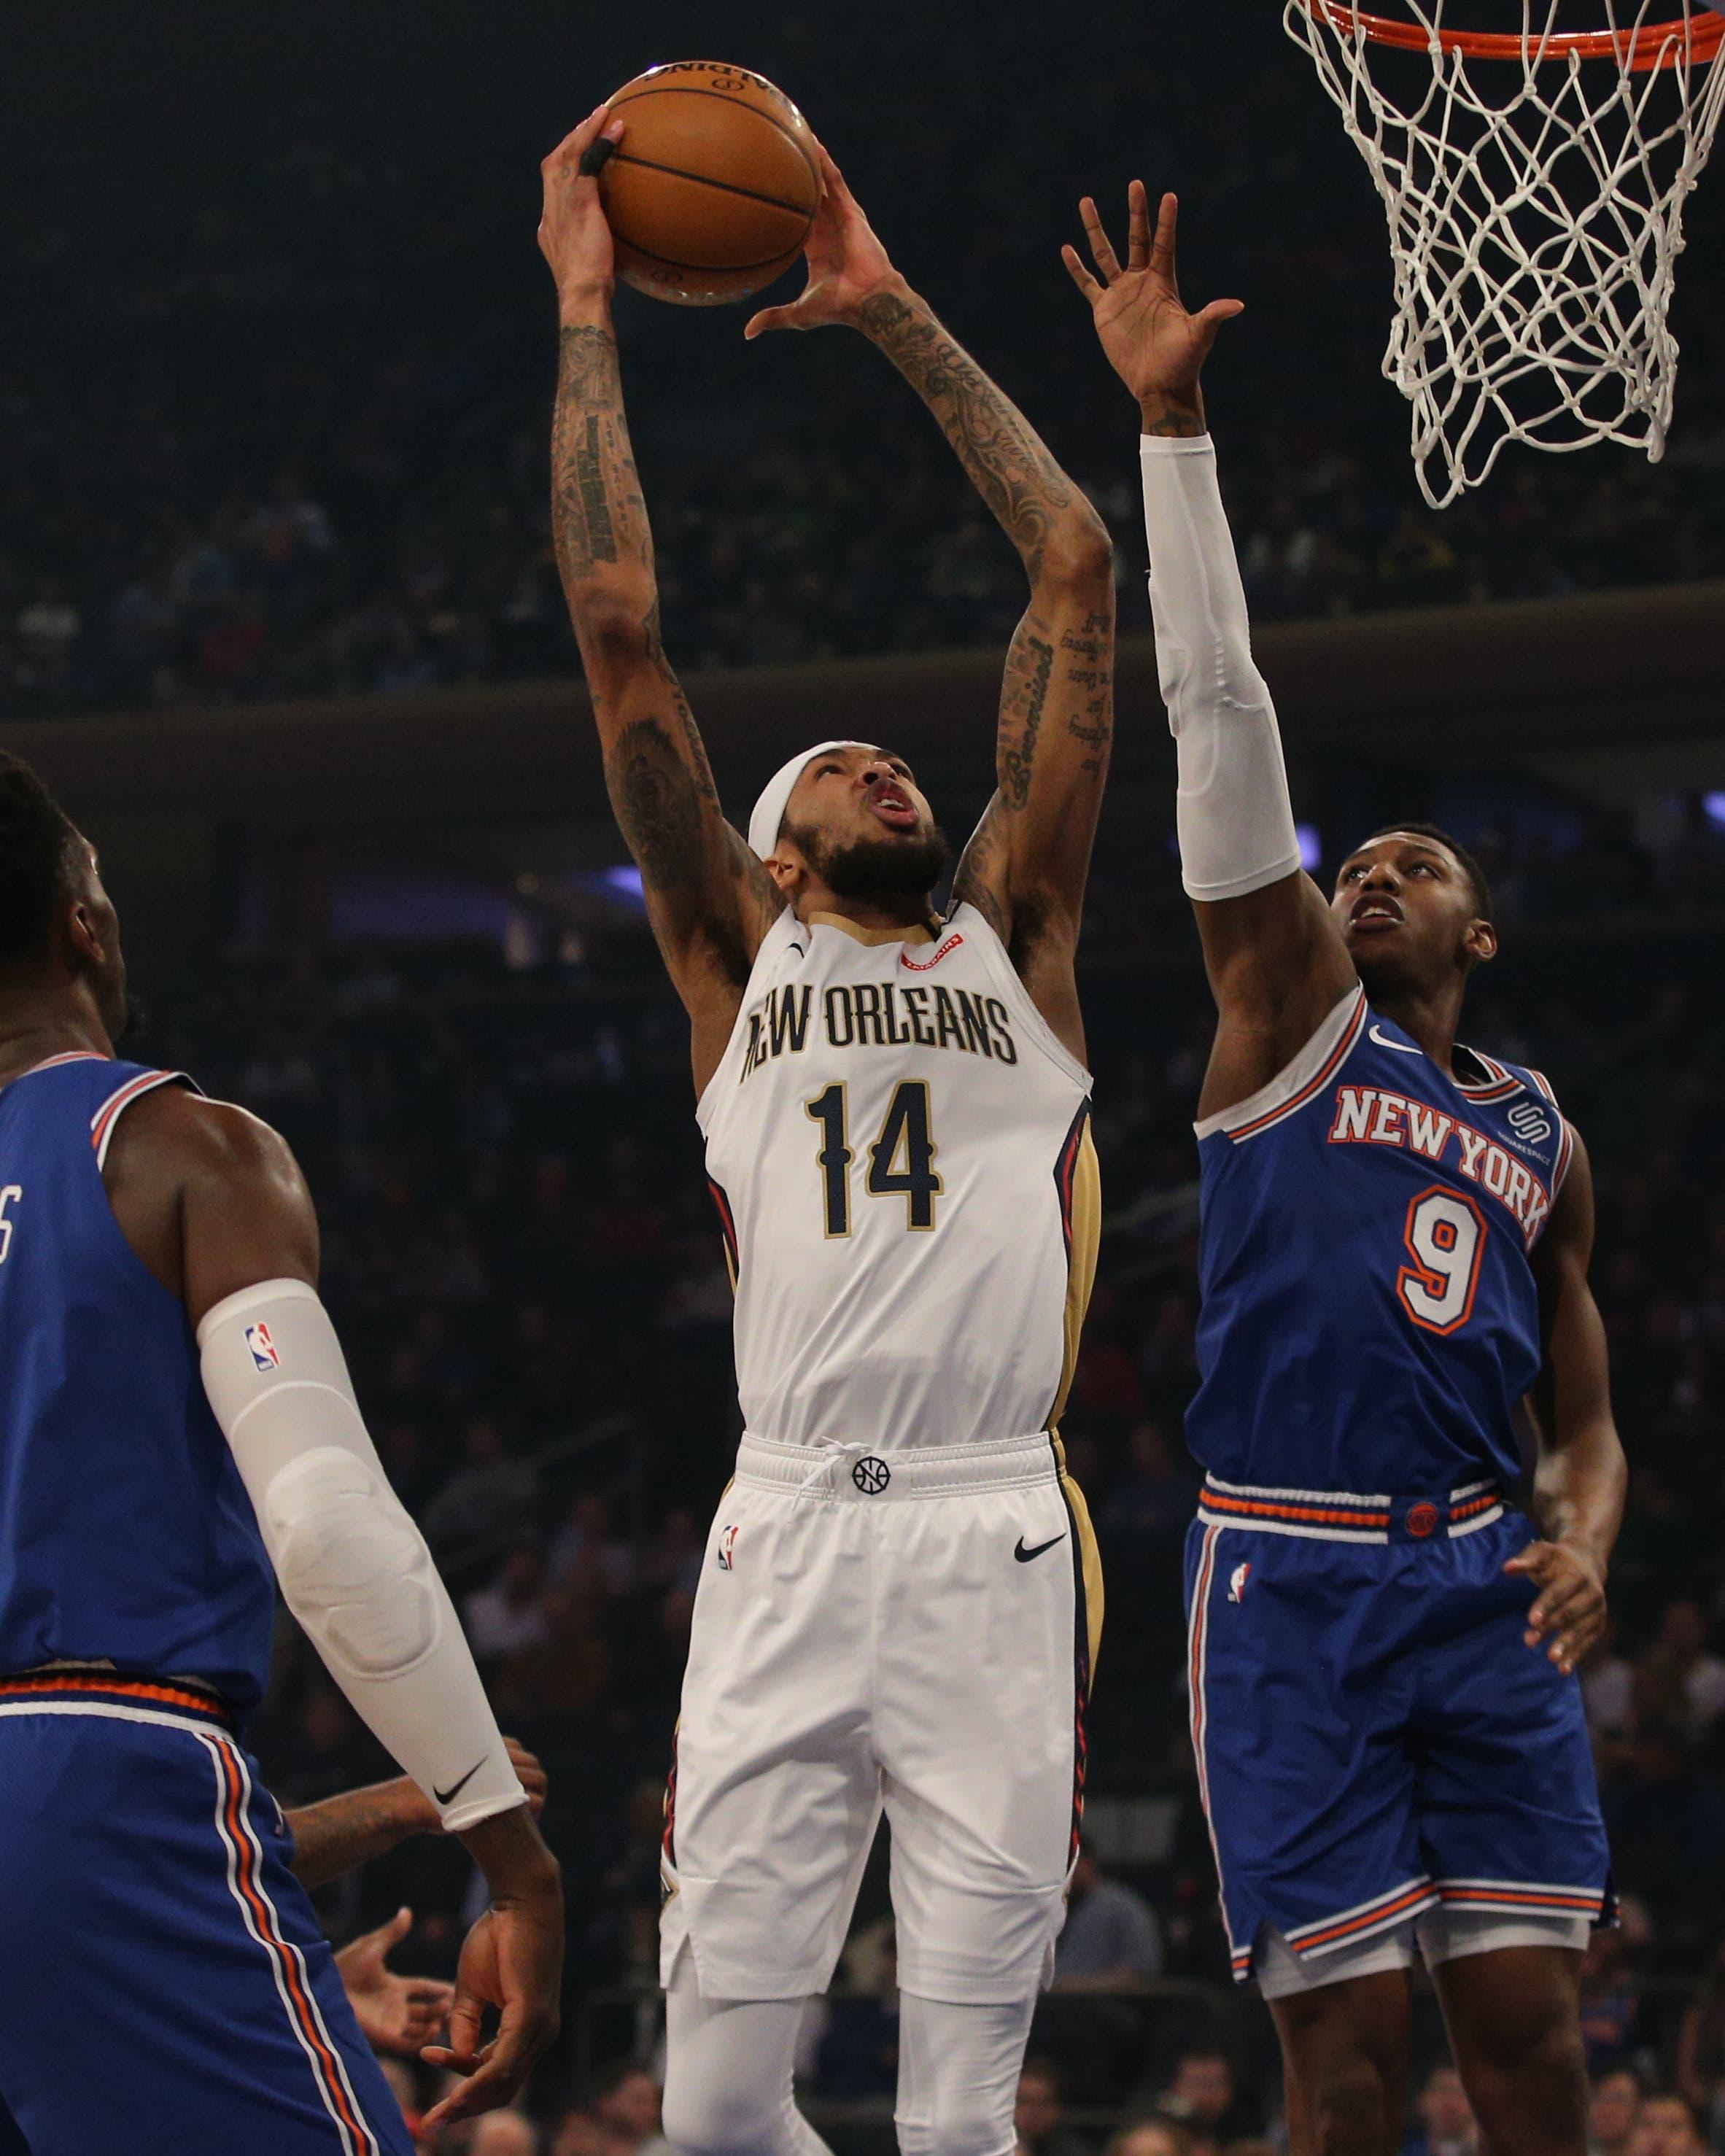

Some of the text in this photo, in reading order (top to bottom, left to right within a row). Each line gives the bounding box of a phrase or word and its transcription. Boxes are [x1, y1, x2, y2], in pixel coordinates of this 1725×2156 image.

[825, 982, 1017, 1066] ORLEANS
[804, 1079, 945, 1239] 14
[1328, 1086, 1551, 1241] NEW YORK
[1396, 1184, 1488, 1336] 9
